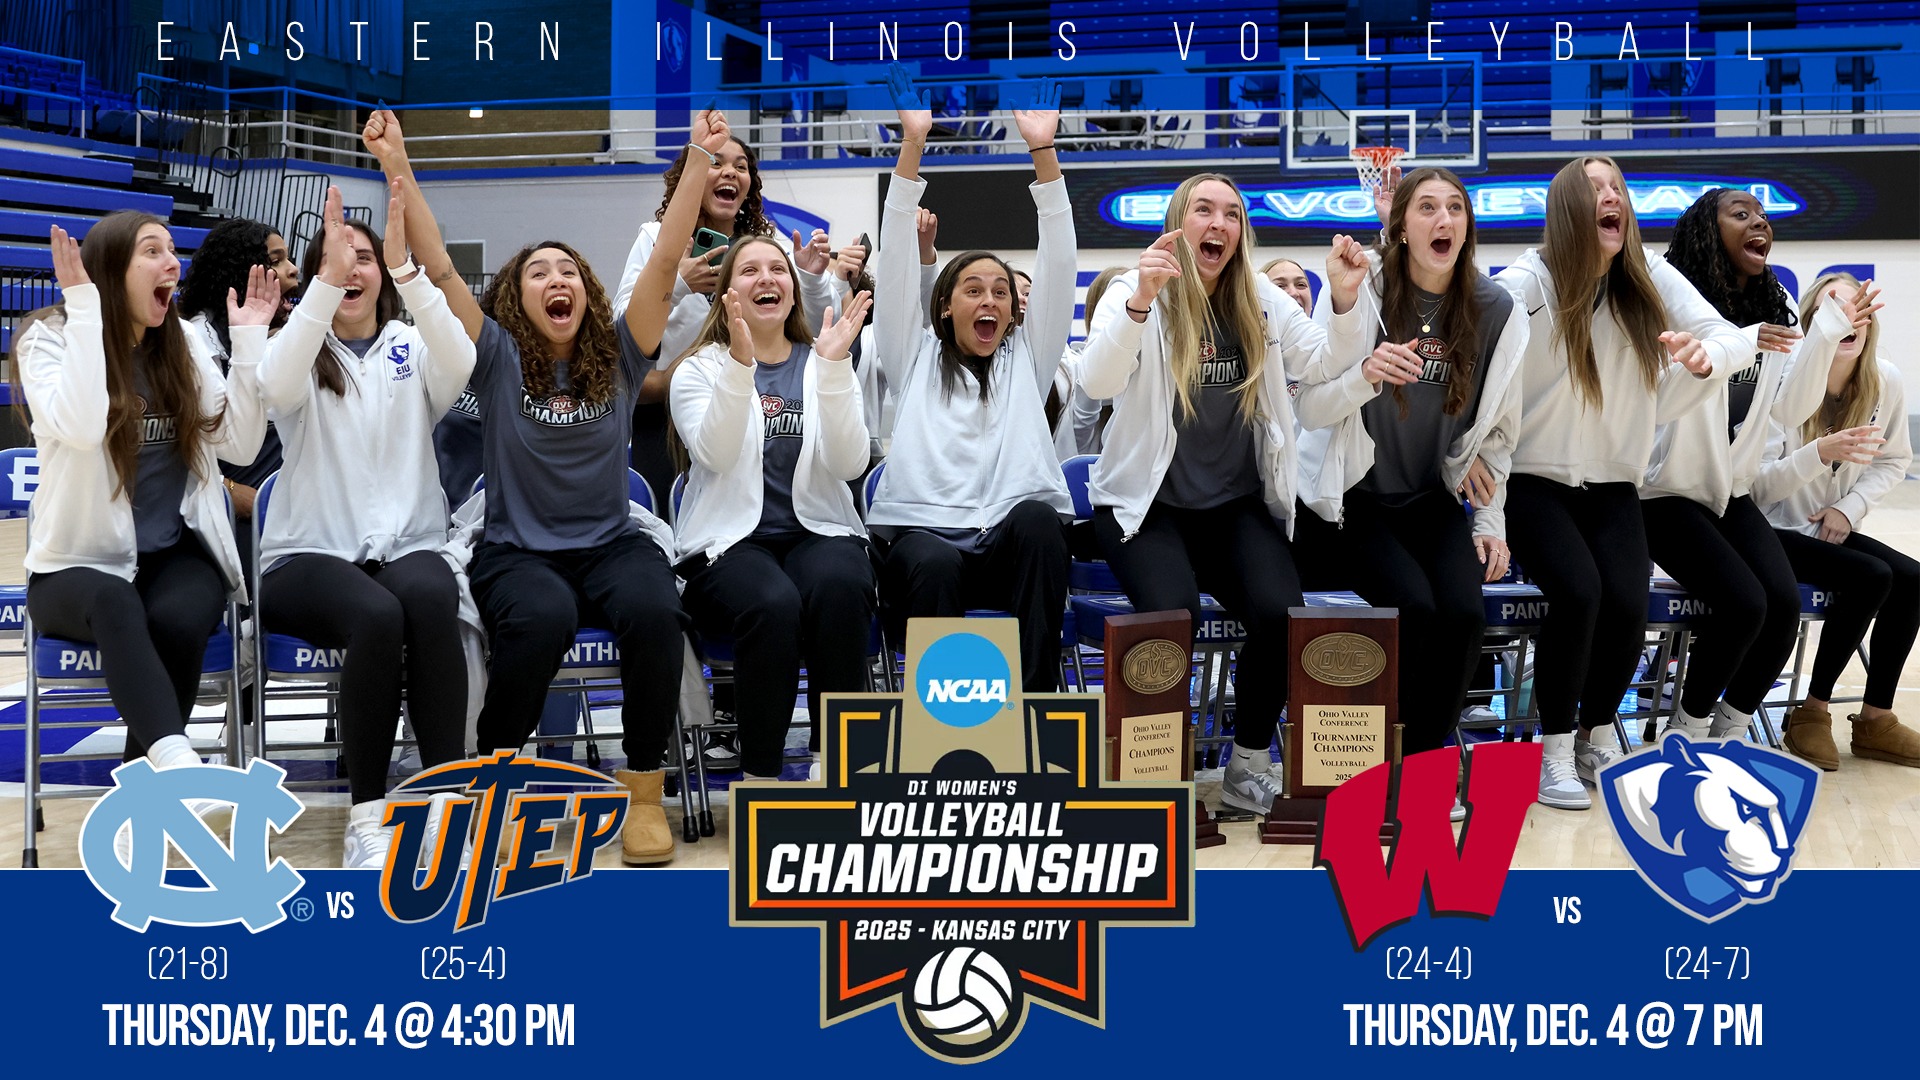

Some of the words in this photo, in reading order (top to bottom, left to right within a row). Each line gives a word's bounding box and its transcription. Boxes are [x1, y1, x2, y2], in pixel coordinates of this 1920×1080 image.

[395, 364, 411, 375] EIU
[1137, 655, 1173, 680] OVC
[1319, 649, 1367, 671] OVC
